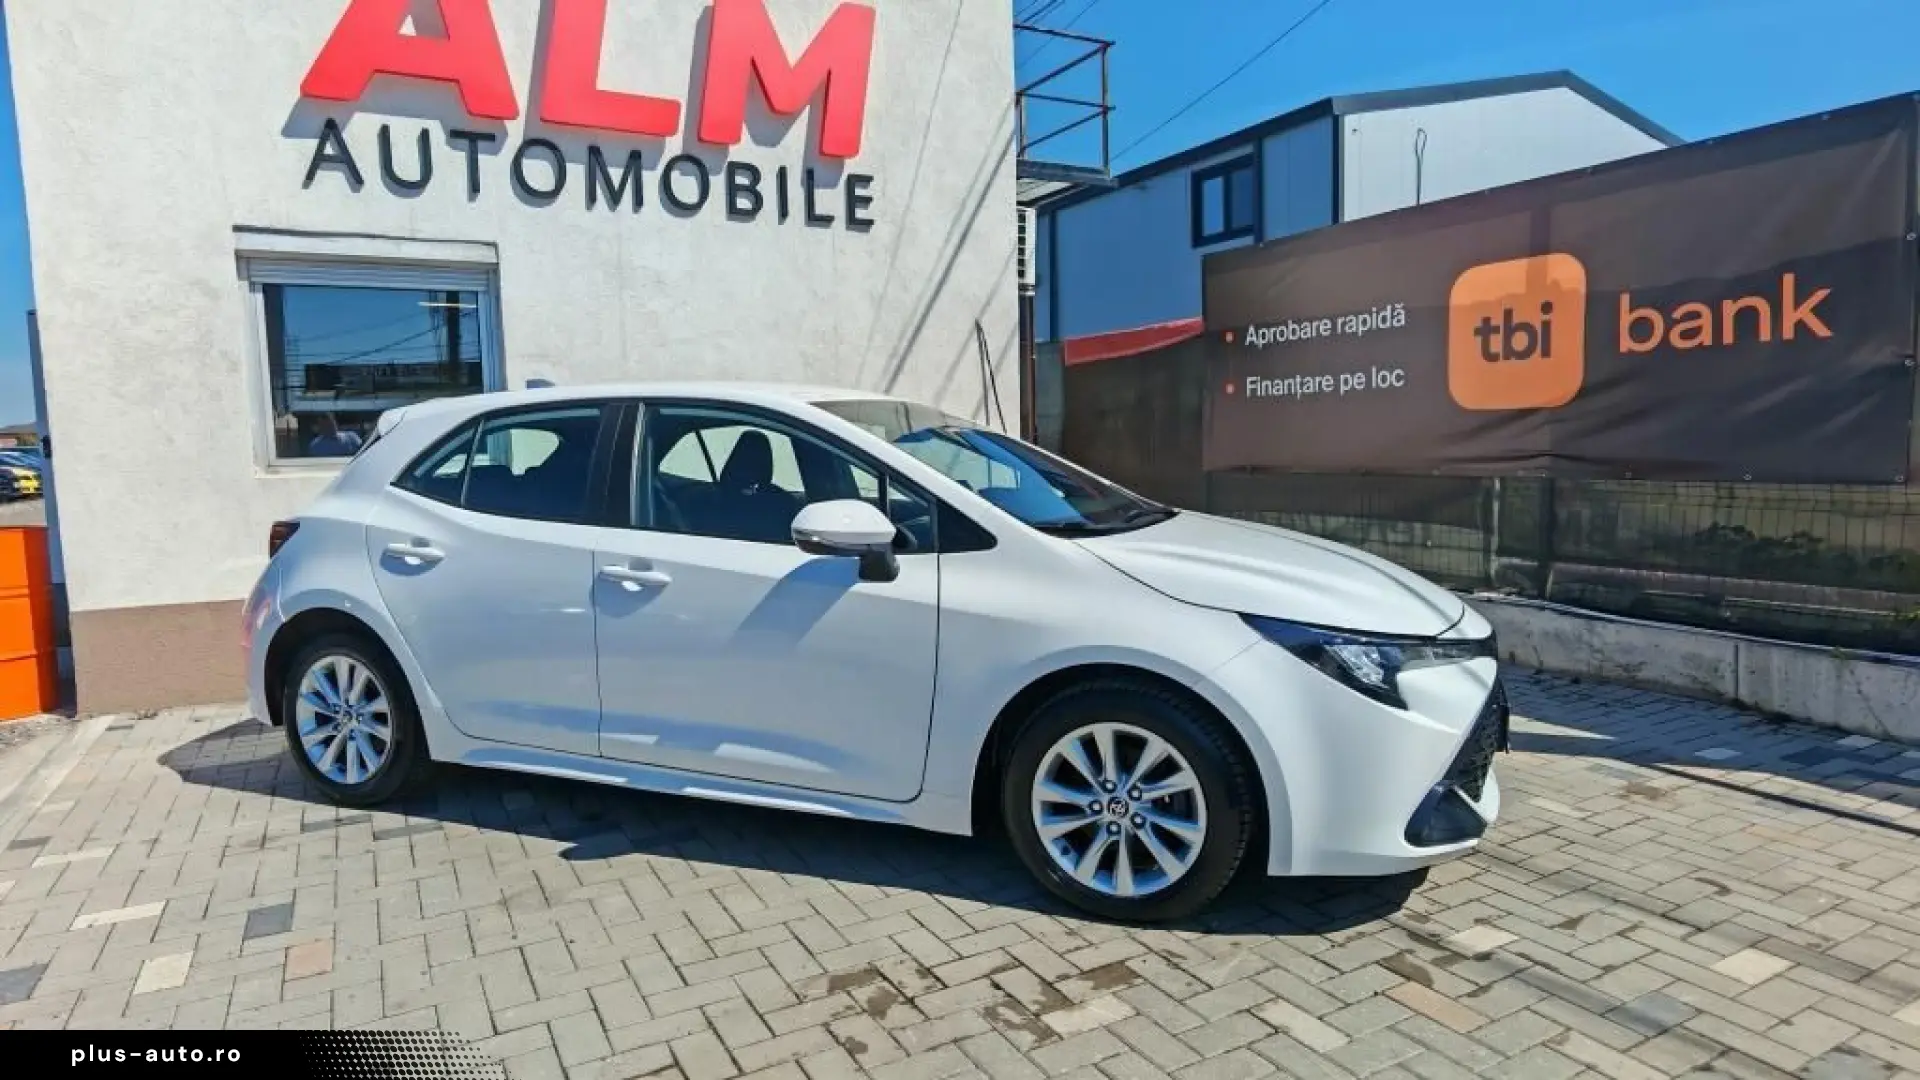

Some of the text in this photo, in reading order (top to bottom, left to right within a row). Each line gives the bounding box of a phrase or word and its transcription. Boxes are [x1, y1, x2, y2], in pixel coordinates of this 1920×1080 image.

[300, 0, 876, 160] ALM
[301, 117, 876, 228] AUTOMOBILE
[1244, 303, 1406, 350] Aprobare rapidă
[1473, 272, 1833, 363] tbi bank
[1246, 365, 1406, 400] Finanțare pe loc
